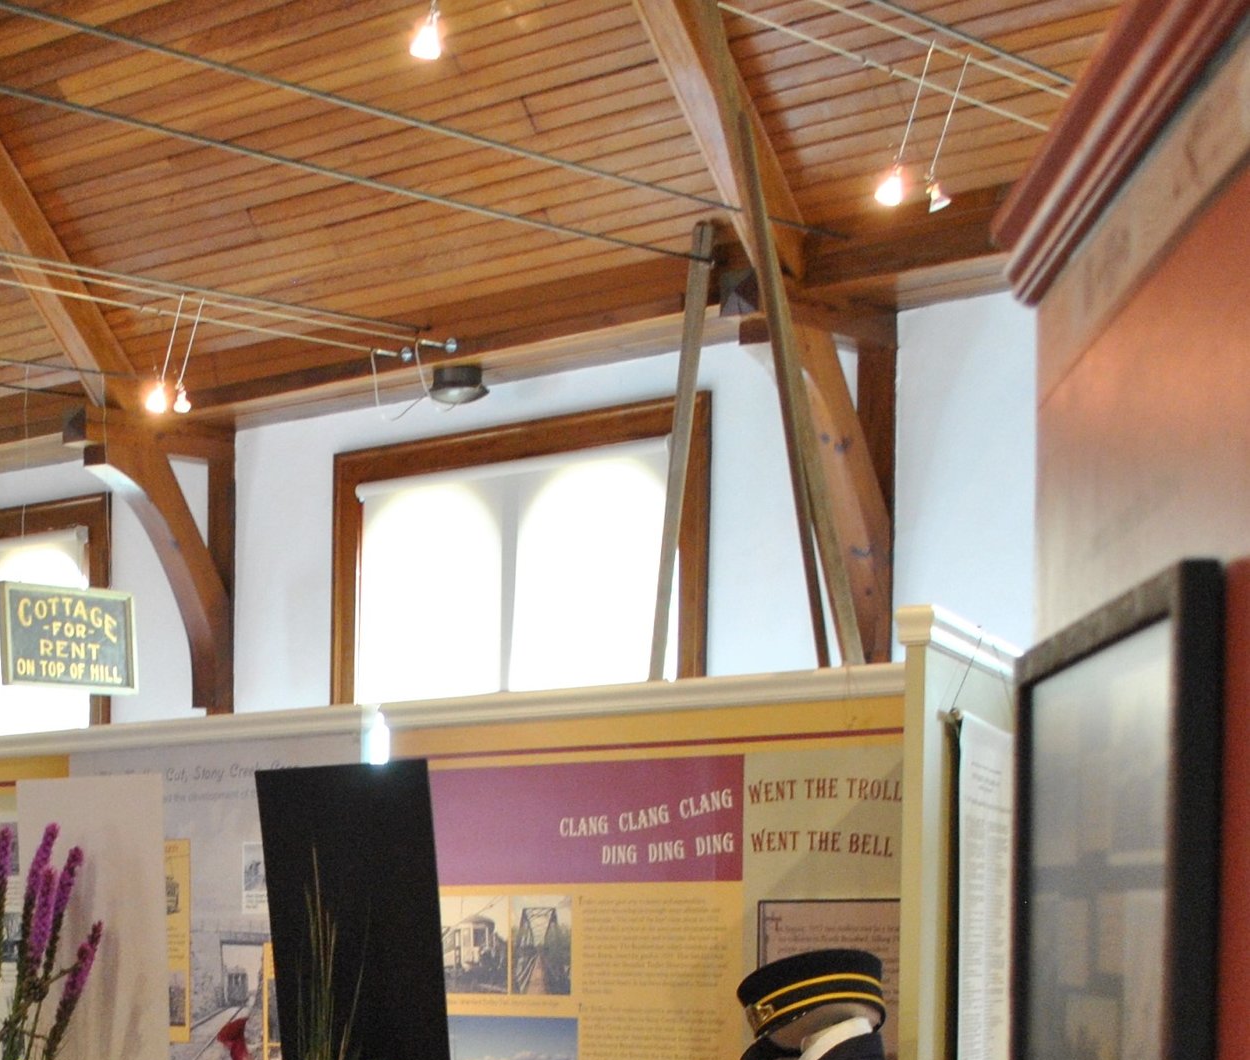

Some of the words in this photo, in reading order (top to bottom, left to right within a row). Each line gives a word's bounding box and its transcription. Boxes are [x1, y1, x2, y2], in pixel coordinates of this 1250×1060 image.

[17, 597, 117, 643] COTTAGE
[39, 639, 100, 660] RENT
[16, 657, 35, 676] ON
[39, 660, 65, 678] TOP
[69, 662, 85, 679] OF
[90, 663, 122, 684] HILL
[748, 780, 796, 804] WENT
[804, 778, 838, 799] THE
[846, 777, 903, 802] TROLL
[559, 815, 609, 838] CLANG
[618, 804, 670, 832] CLANG
[679, 788, 733, 820] CLANG
[601, 844, 637, 865] DING
[648, 840, 685, 863] DING
[695, 832, 734, 857] DING
[751, 829, 800, 853] WENT
[807, 831, 842, 853] THE
[848, 832, 894, 858] BELL
